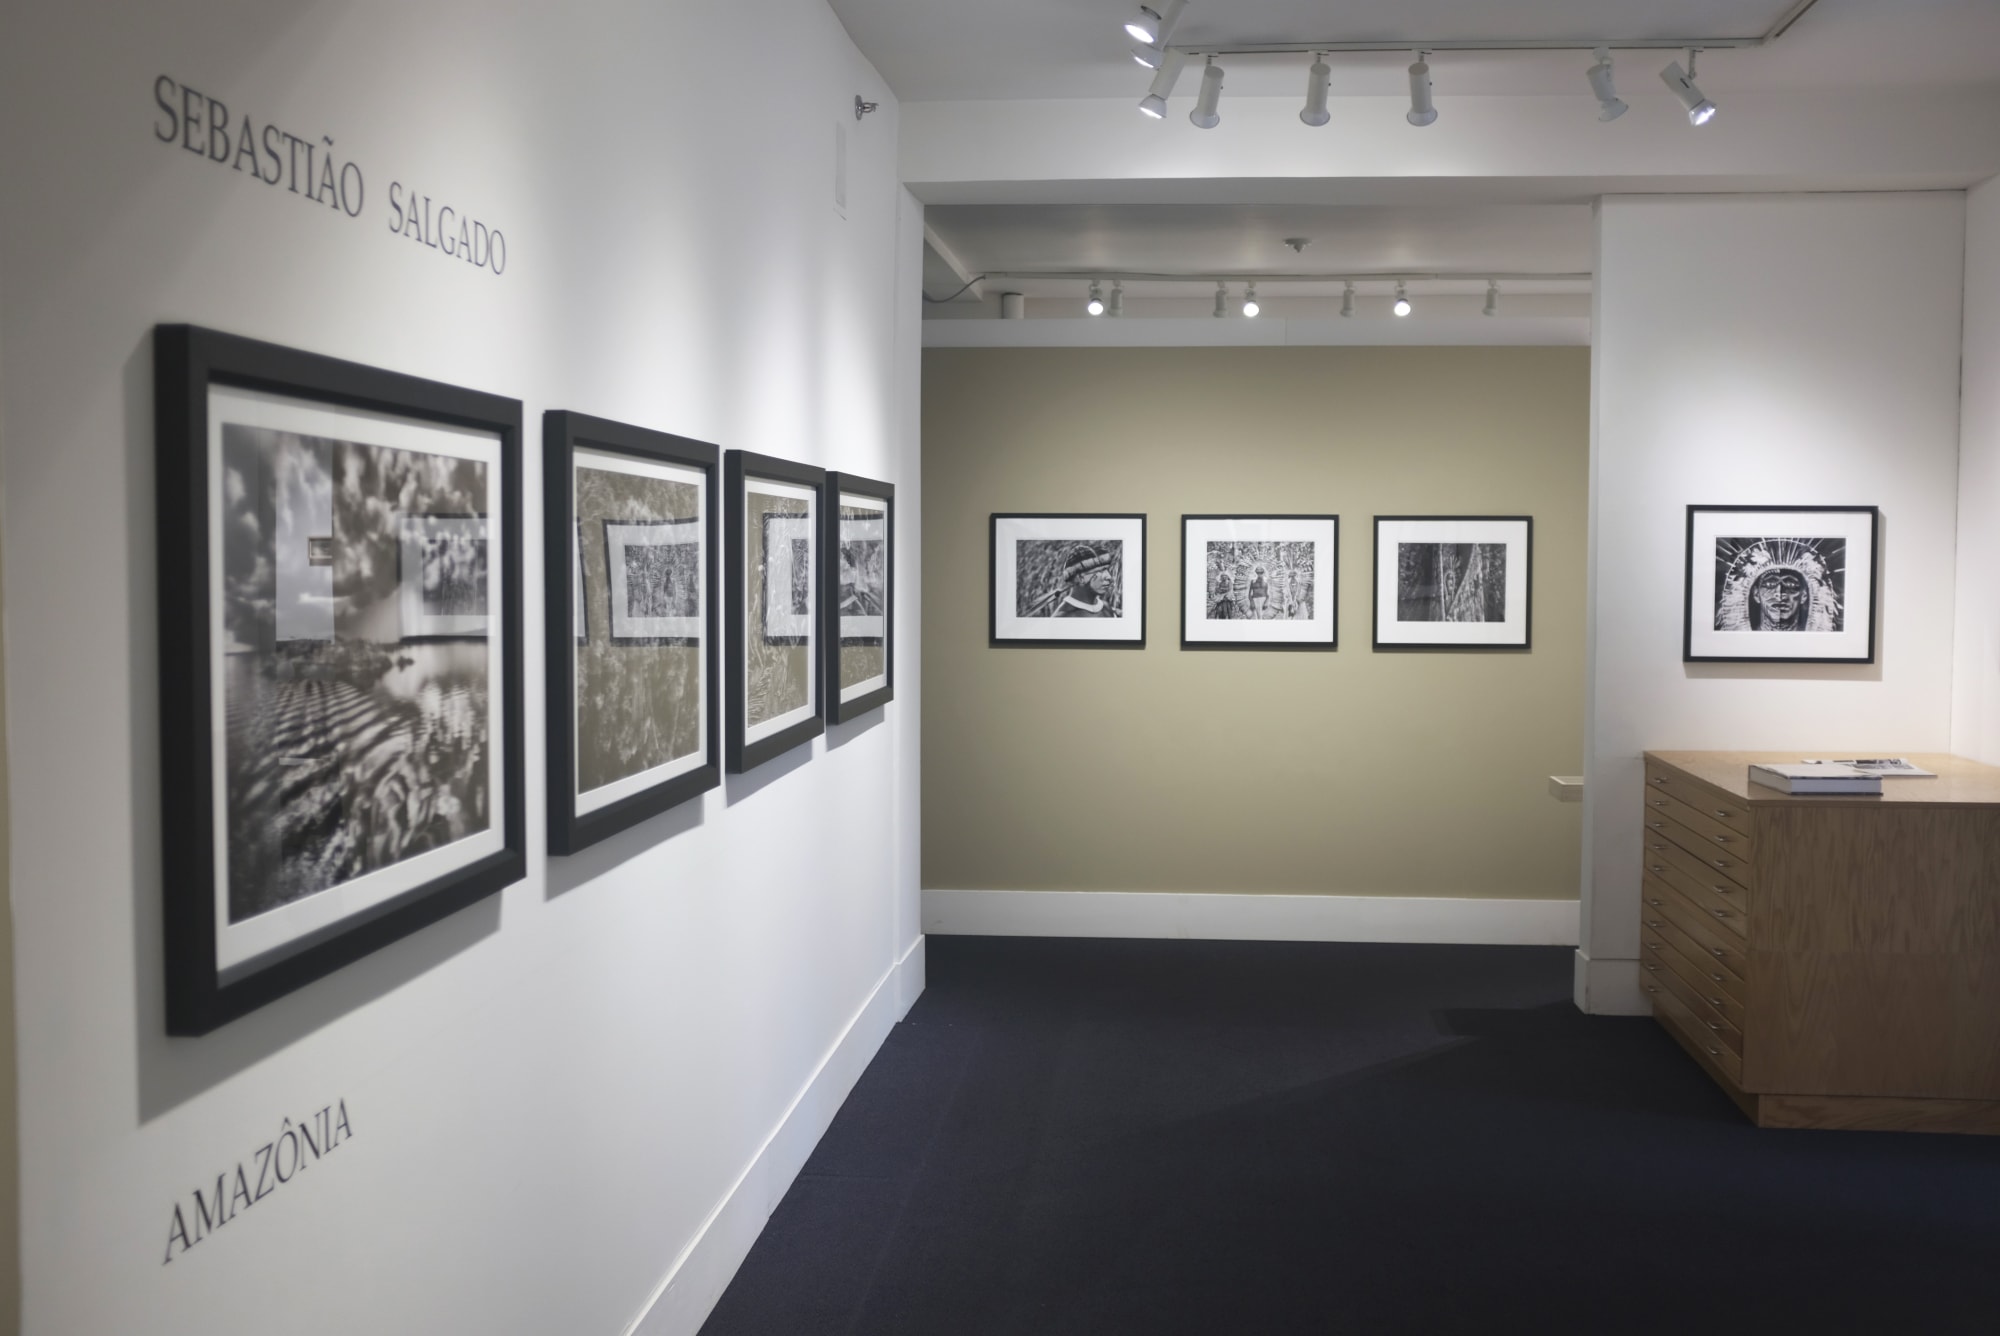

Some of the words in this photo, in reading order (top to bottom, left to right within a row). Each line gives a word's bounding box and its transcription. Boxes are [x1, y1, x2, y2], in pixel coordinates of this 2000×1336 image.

[153, 74, 365, 218] SEBASTIÃO
[388, 180, 507, 276] SALGADO
[162, 1097, 353, 1266] AMAZÔNIA
